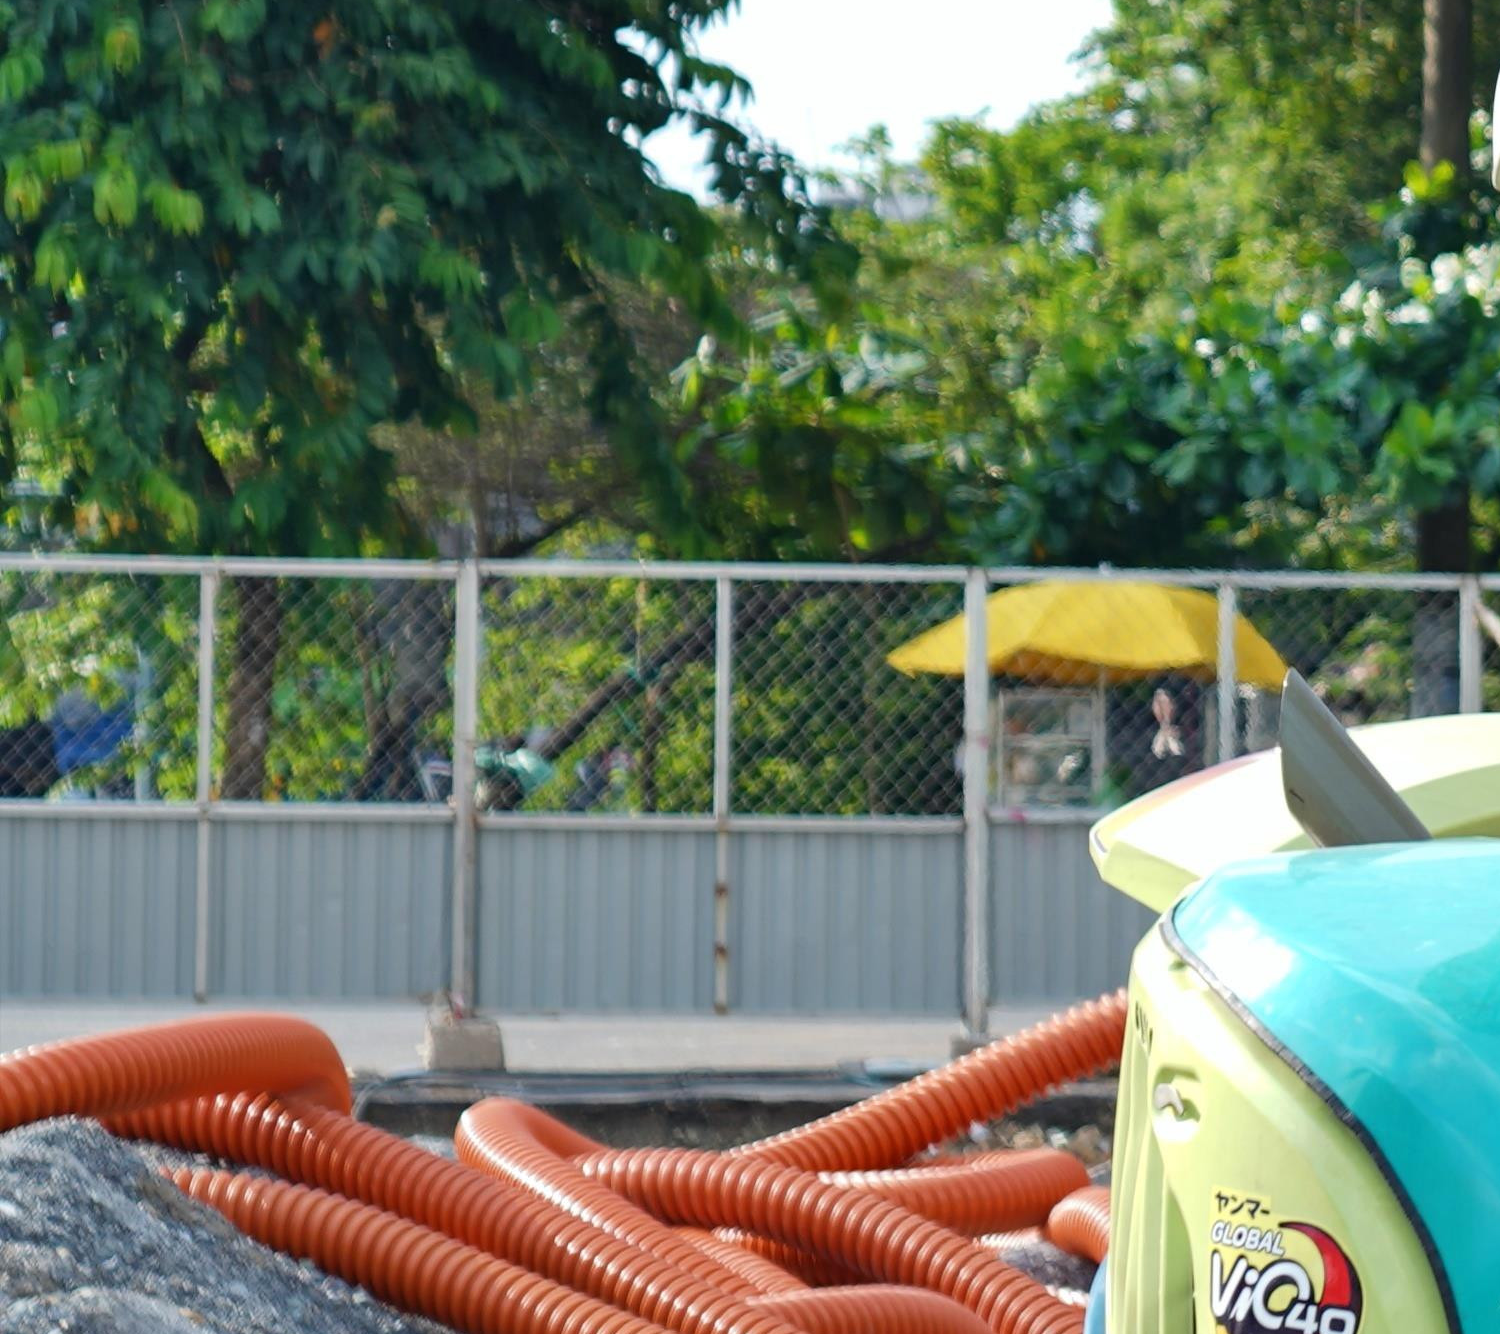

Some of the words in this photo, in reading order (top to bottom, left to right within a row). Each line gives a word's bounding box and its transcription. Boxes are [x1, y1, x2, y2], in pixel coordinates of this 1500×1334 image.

[1215, 1190, 1271, 1220] ヤンマー
[1211, 1219, 1286, 1257] GLOBAL
